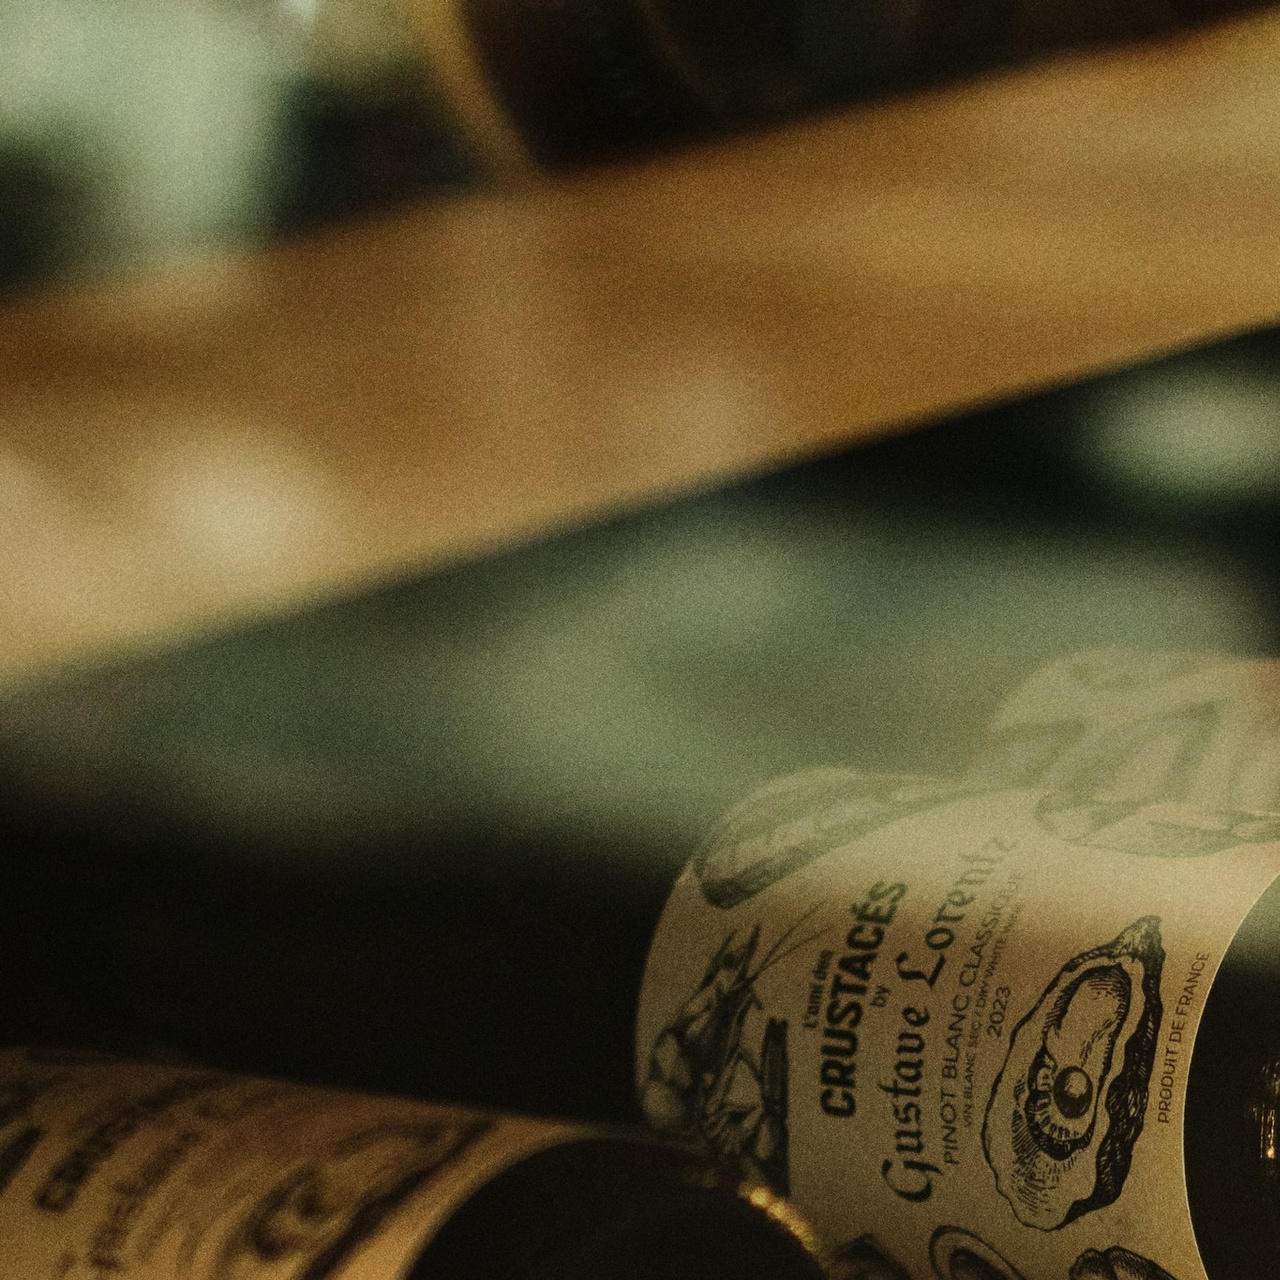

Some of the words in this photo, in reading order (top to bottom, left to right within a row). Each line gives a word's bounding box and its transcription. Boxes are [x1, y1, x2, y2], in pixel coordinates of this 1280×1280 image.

[820, 881, 907, 1118] CRUSTACÉS
[870, 985, 891, 1007] by
[986, 986, 1011, 1038] 2023
[1176, 952, 1210, 1016] FRANCE
[942, 995, 969, 1080] BLANC
[1169, 1021, 1185, 1043] DE
[877, 1004, 940, 1203] Gustave
[1158, 1047, 1179, 1124] PRODUIT
[941, 1089, 959, 1165] PINOT
